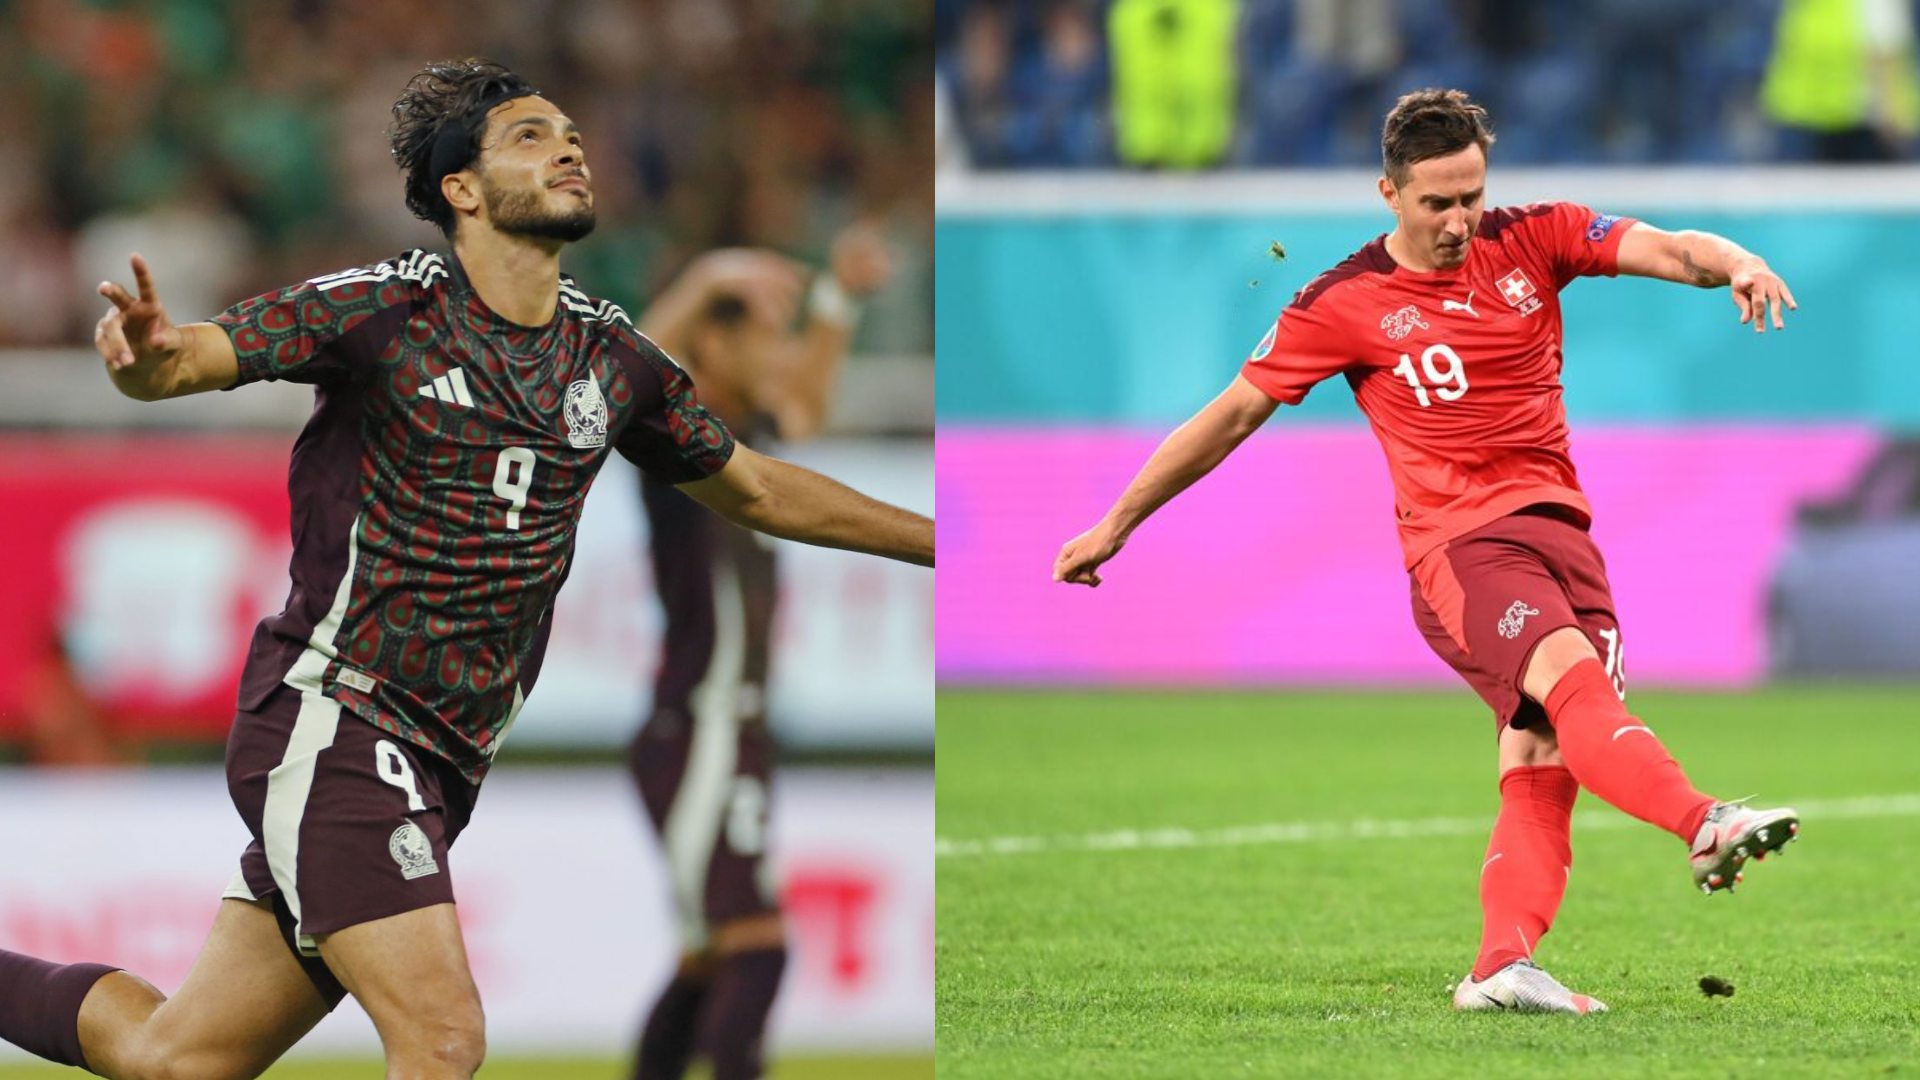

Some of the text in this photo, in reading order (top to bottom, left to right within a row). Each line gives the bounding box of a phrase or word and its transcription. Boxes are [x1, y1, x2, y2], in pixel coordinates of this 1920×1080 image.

[1392, 344, 1469, 407] 19
[492, 446, 536, 530] 9
[375, 739, 427, 811] 9
